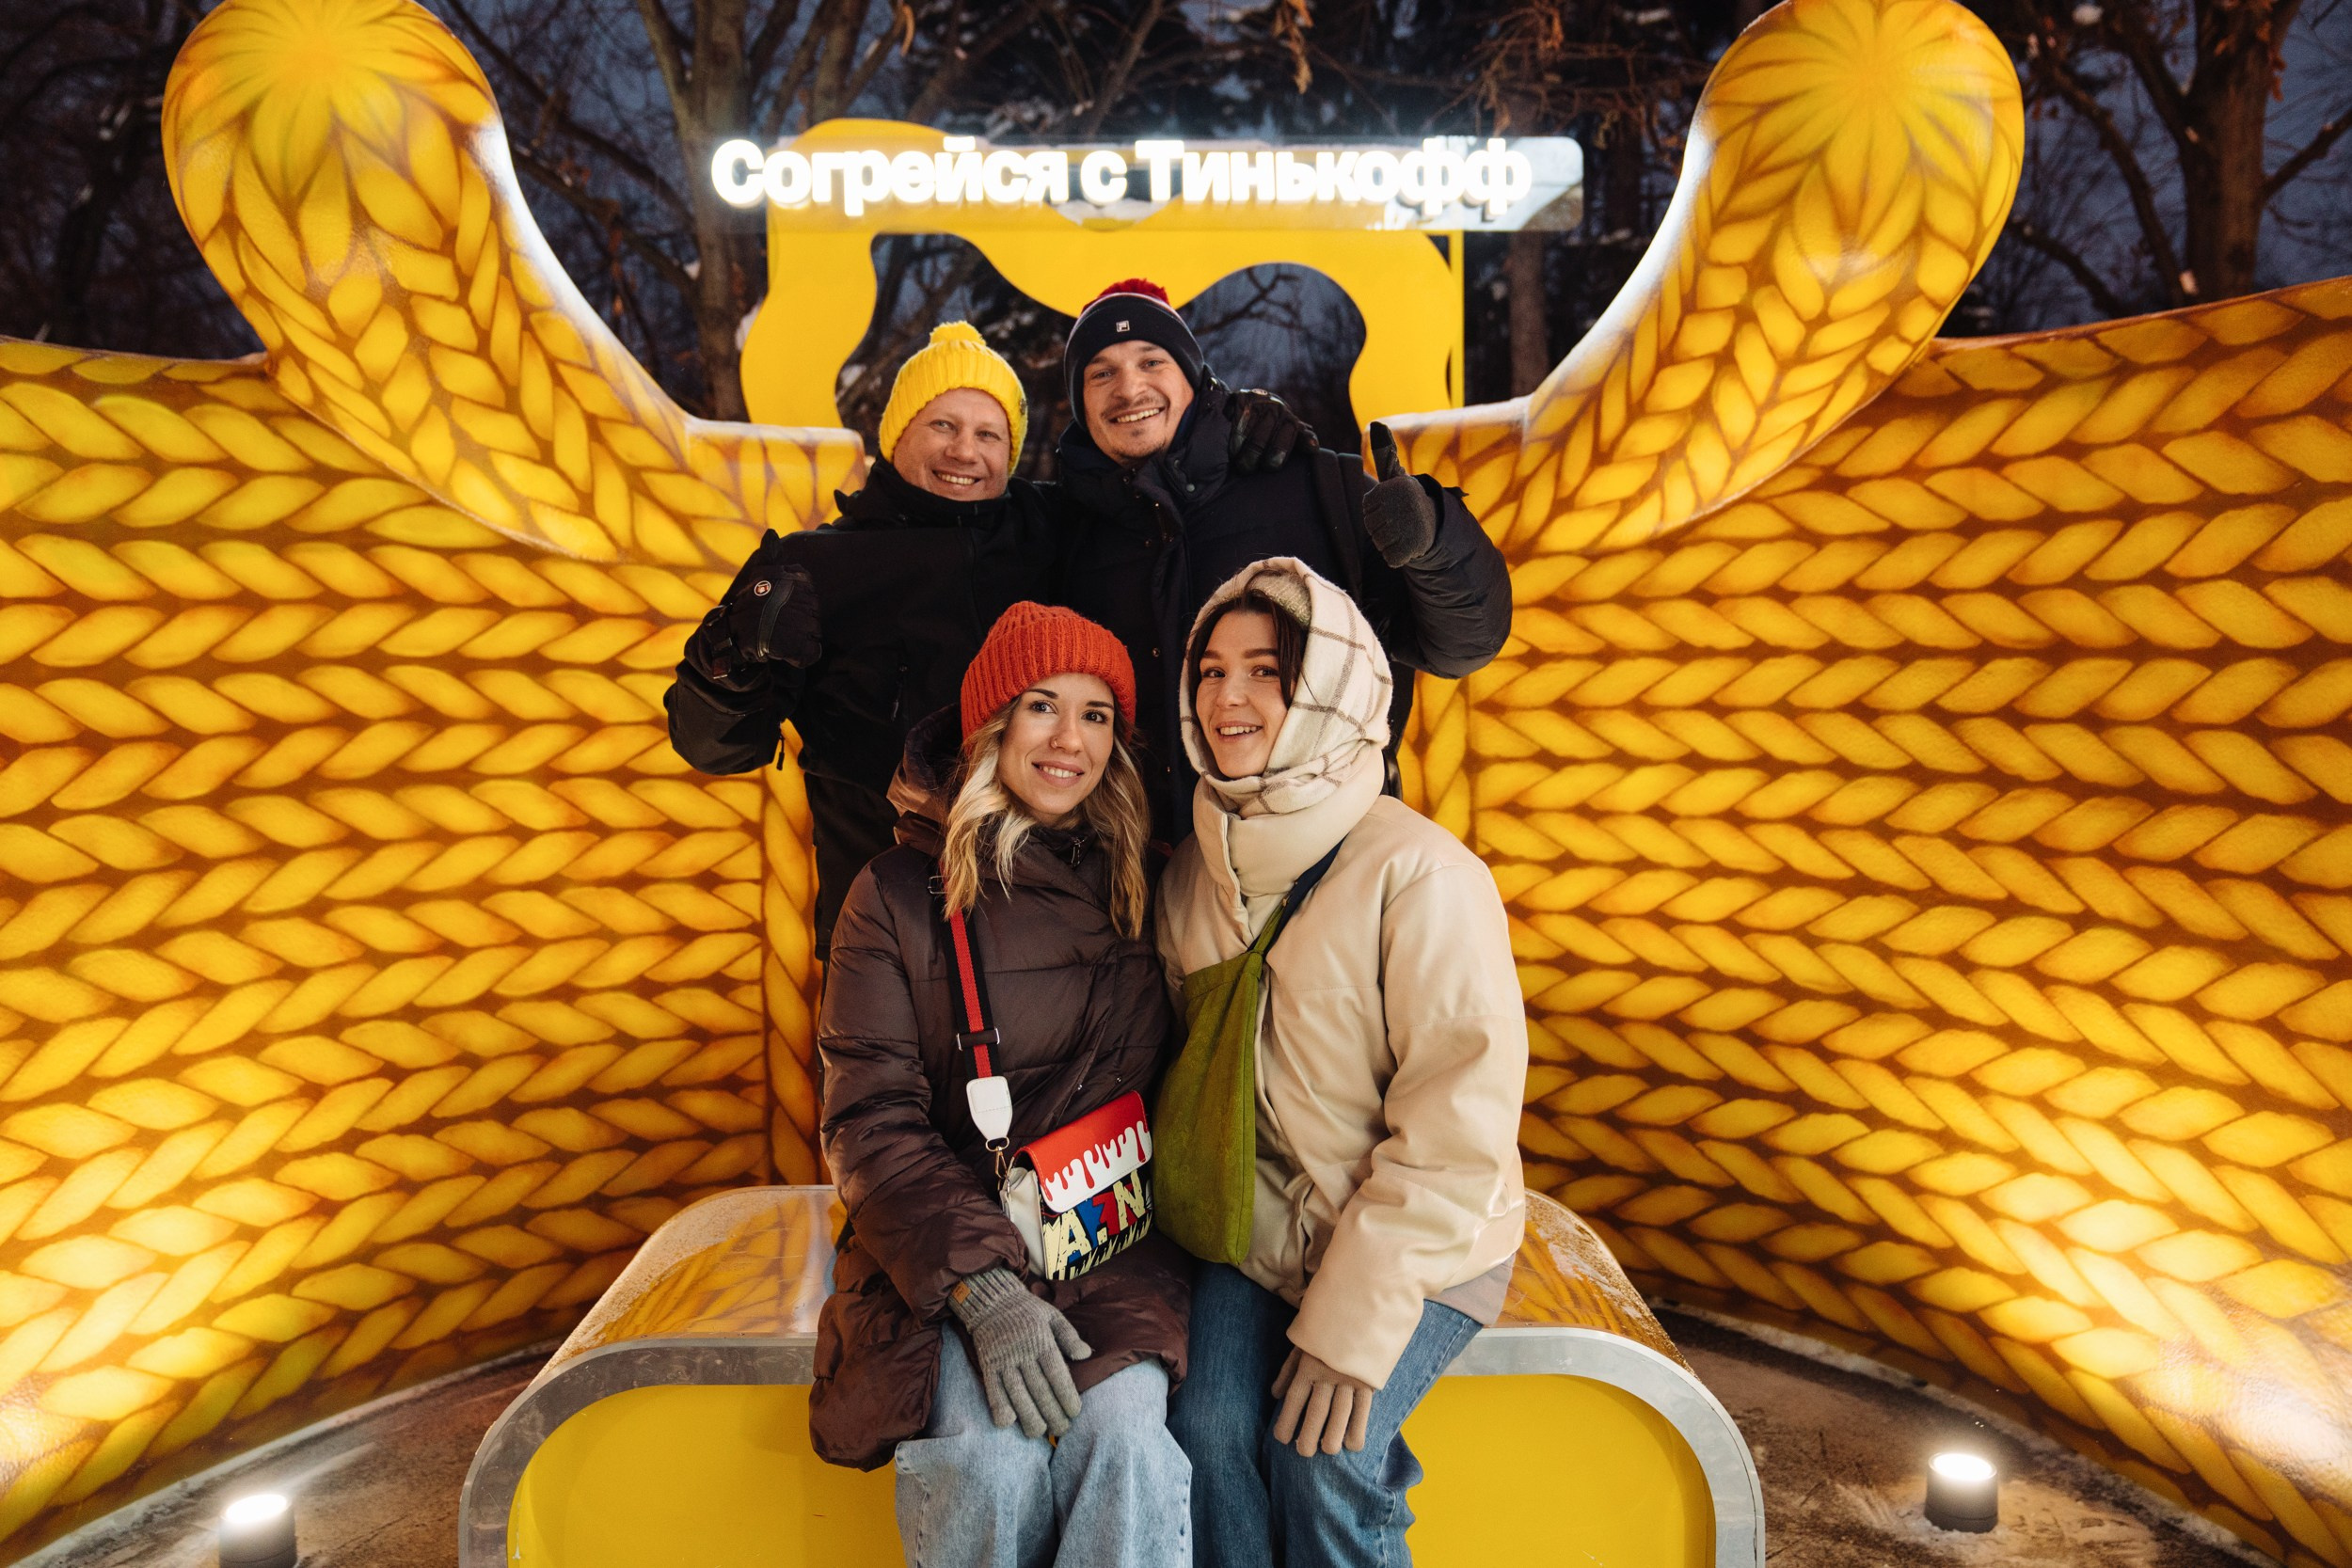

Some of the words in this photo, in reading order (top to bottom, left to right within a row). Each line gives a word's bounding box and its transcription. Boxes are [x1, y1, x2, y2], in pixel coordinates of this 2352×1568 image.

[712, 136, 1068, 215] Согрейся
[1081, 150, 1128, 201] с
[1136, 137, 1532, 216] Тинькофф
